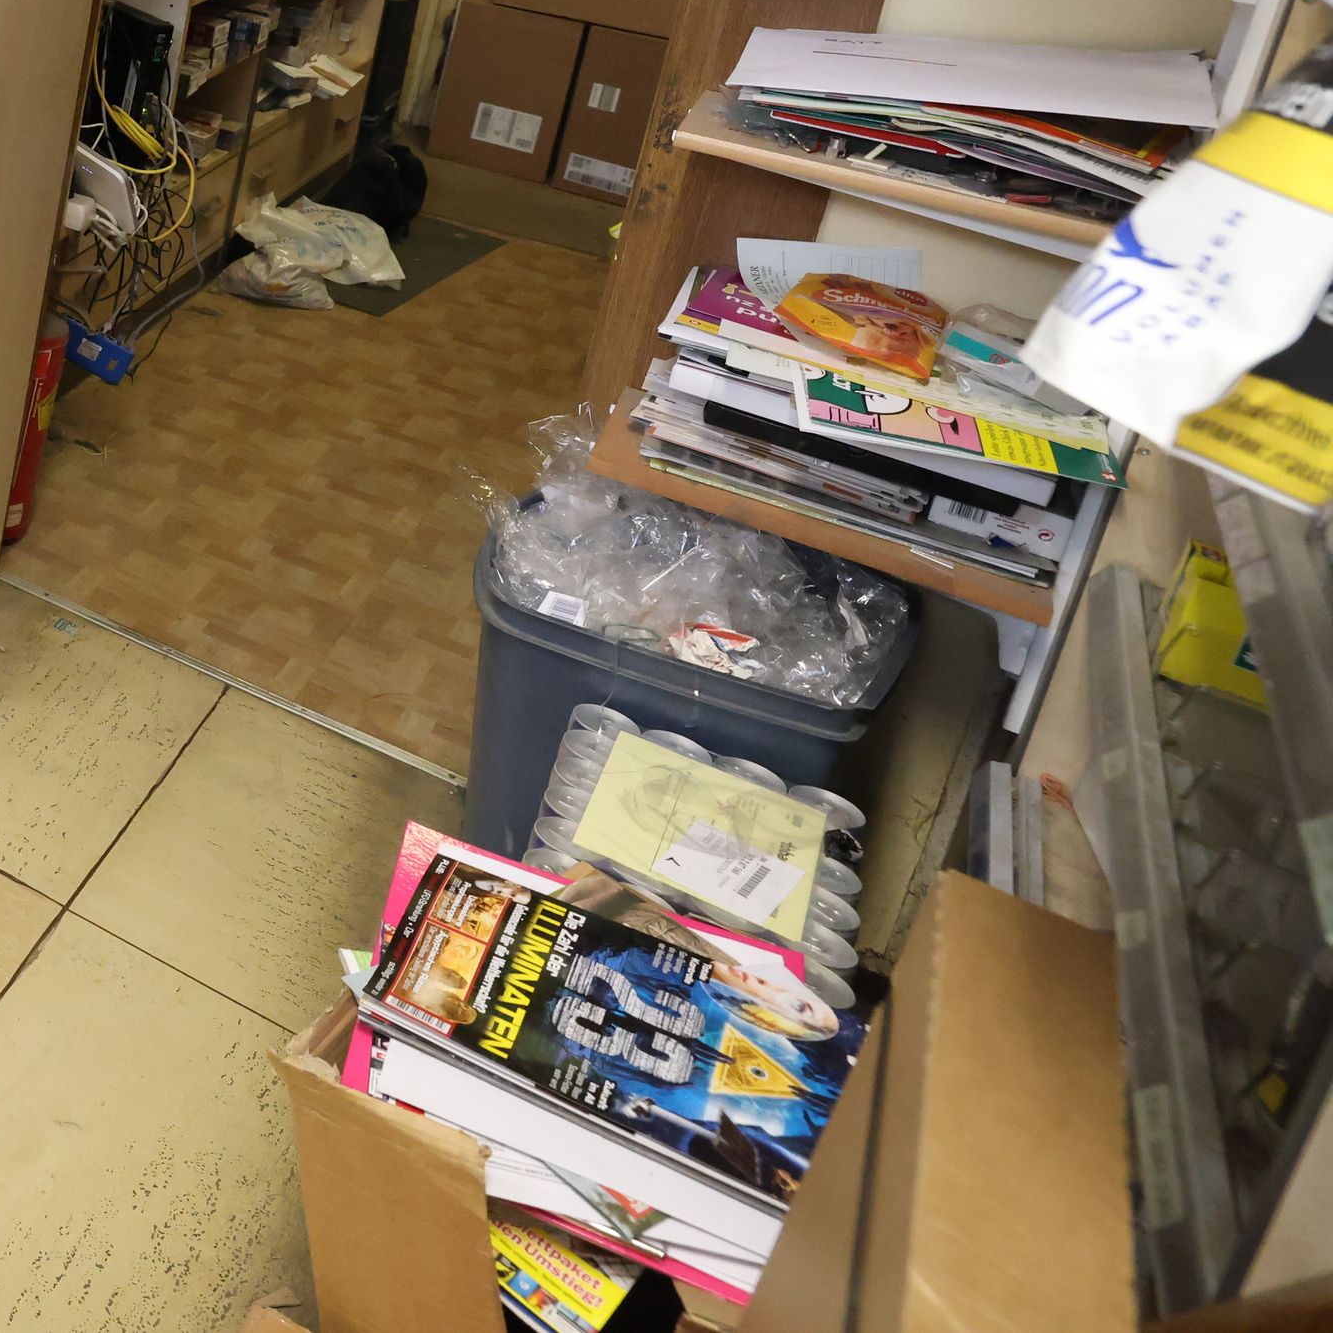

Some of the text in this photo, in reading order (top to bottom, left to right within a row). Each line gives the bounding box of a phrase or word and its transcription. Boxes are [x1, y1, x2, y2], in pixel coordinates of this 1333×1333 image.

[478, 900, 567, 1059] ILLUMINATEN
[546, 911, 586, 977] Die Zahl der
[552, 954, 706, 1084] 23
